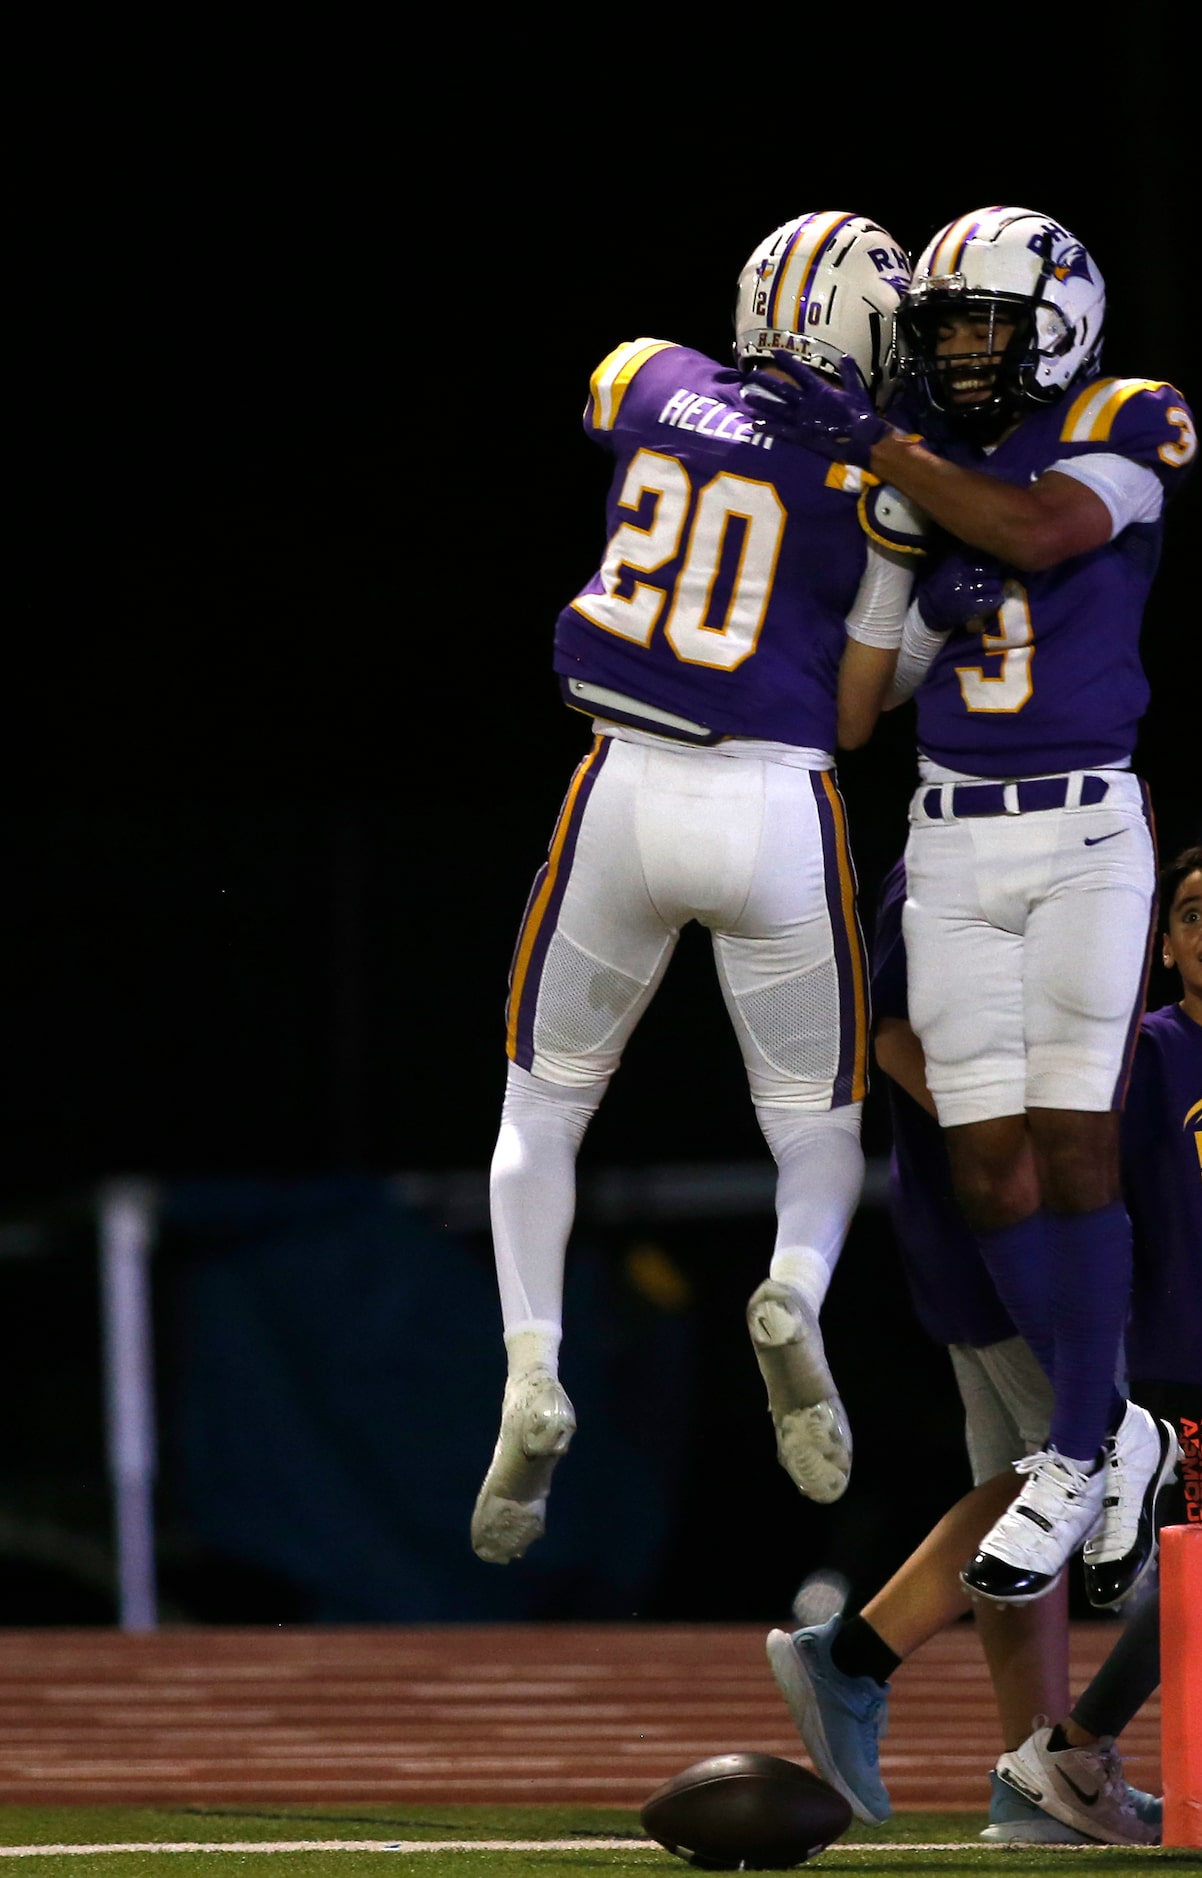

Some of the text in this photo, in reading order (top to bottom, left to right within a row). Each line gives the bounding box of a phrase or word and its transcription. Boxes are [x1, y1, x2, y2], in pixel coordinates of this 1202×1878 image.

[1157, 406, 1197, 468] 3
[571, 447, 787, 673] 20
[954, 578, 1036, 713] 3
